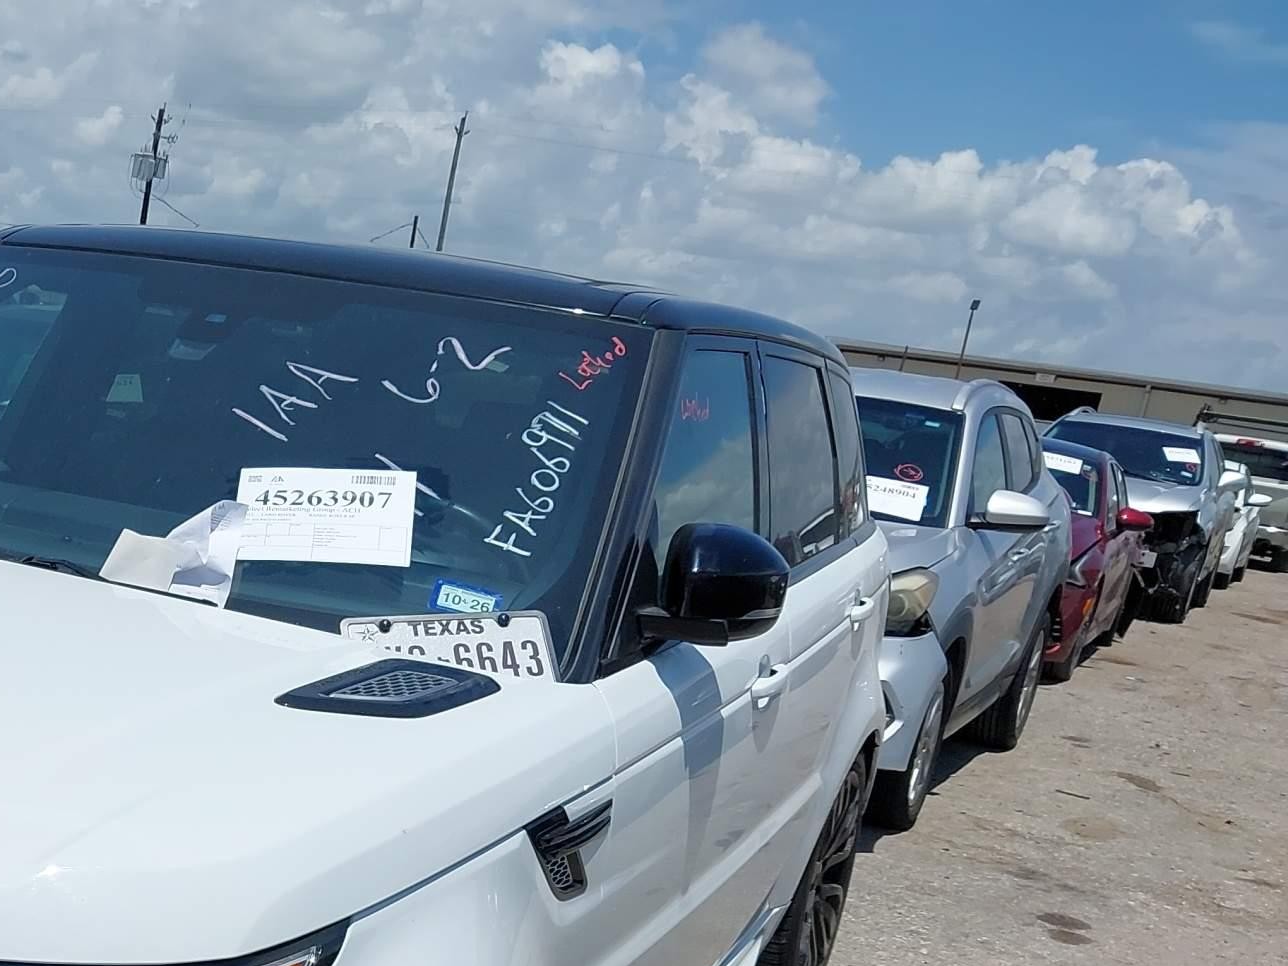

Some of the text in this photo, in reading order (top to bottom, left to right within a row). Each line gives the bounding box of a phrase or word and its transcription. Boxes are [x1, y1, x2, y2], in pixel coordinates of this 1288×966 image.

[381, 337, 512, 403] 6-2
[232, 361, 358, 441] IAA
[254, 489, 393, 508] 45263907
[408, 619, 485, 637] TEXAS
